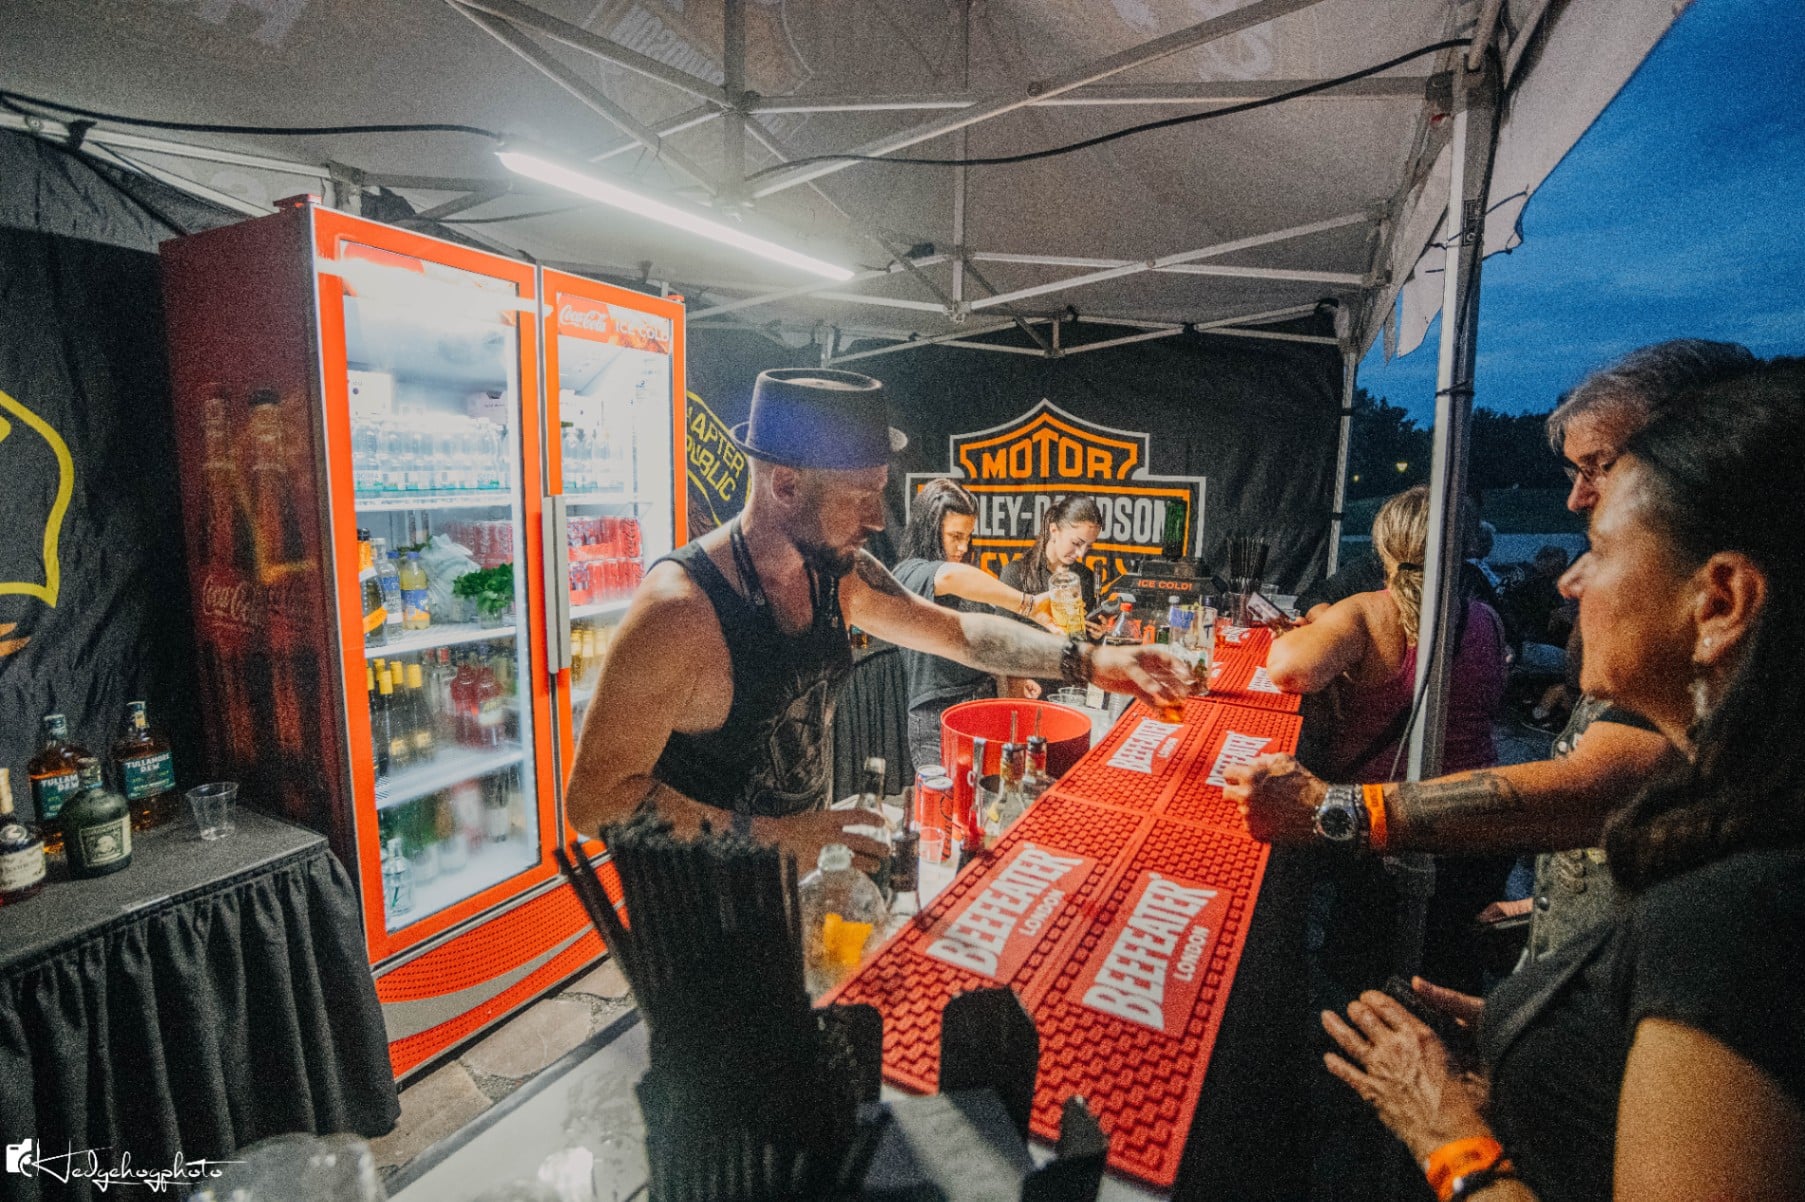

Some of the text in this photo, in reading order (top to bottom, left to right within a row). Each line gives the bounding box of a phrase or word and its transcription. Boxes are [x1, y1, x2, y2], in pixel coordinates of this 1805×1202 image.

[686, 406, 746, 480] APTER
[982, 427, 1113, 480] MOTOR
[1137, 579, 1192, 591] ICE COLD!
[1105, 717, 1184, 775] BEEFEATER
[41, 774, 79, 786] TULLAM
[926, 847, 1084, 977] BEEFEATER
[1018, 888, 1066, 937] LONDON
[1082, 877, 1218, 1031] BEEFEATER
[1172, 924, 1210, 982] LONDON
